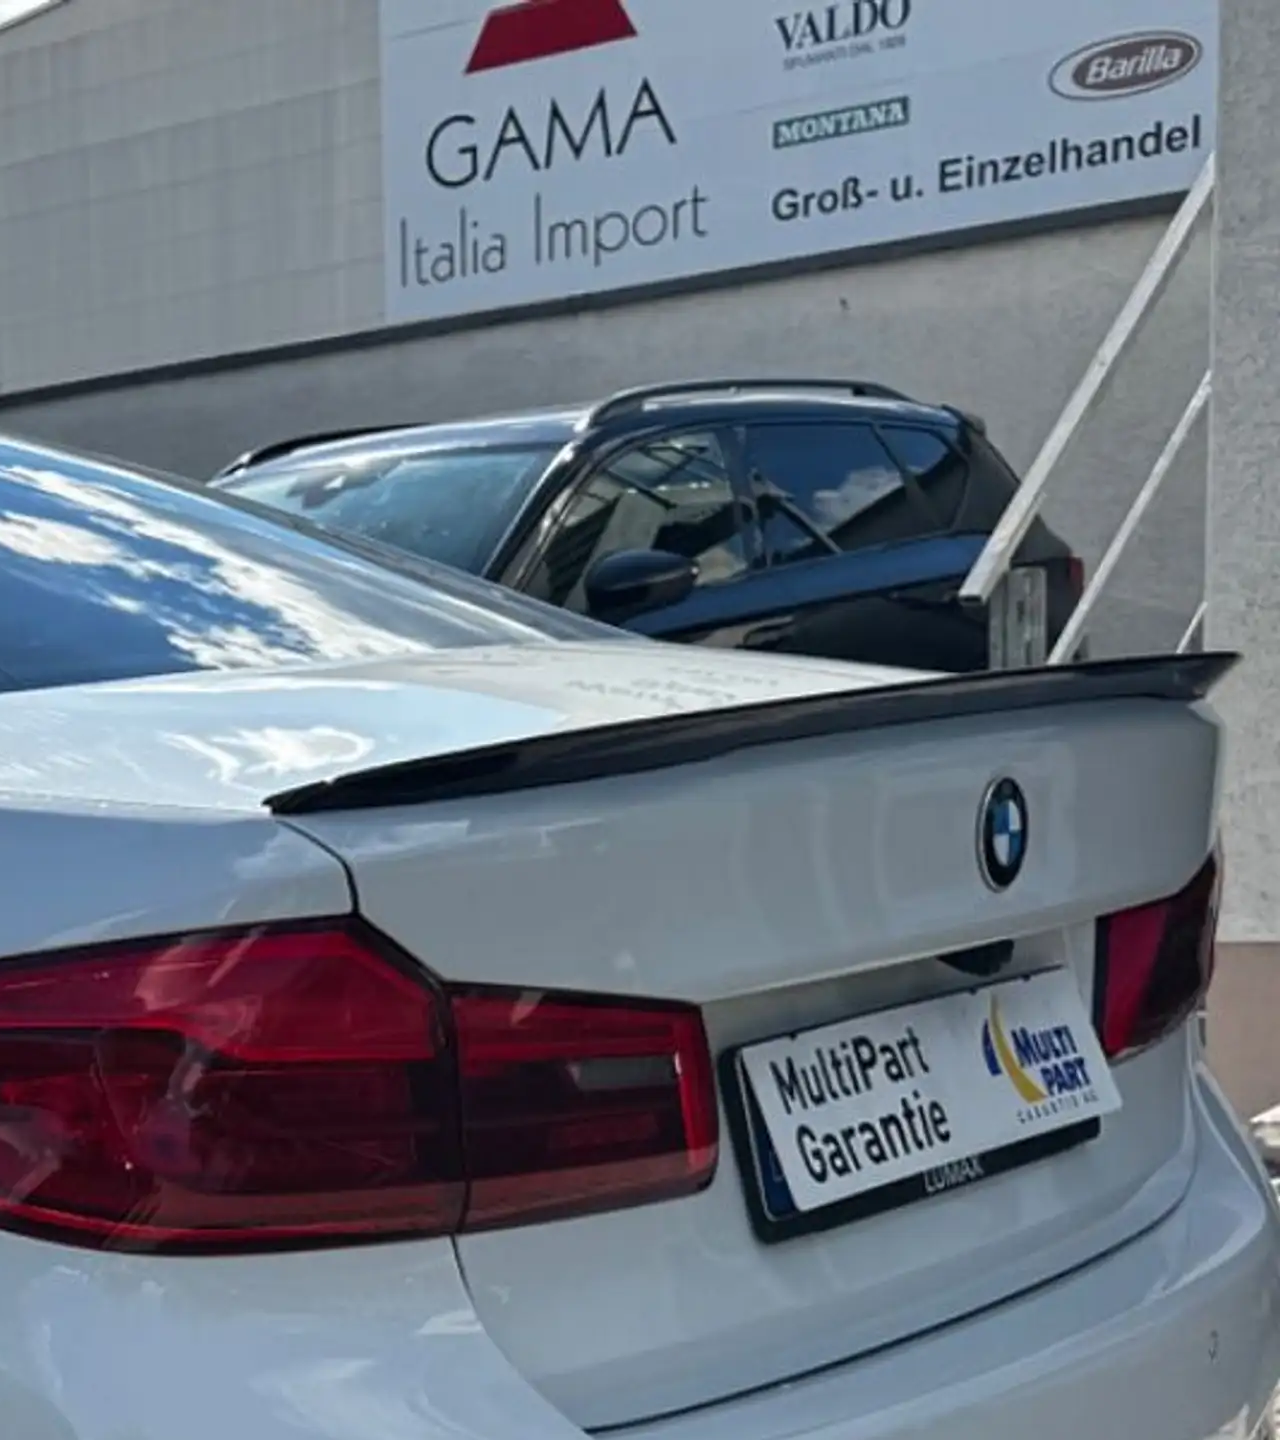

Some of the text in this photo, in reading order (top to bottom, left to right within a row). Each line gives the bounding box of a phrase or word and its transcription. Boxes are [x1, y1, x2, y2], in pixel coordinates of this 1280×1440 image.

[775, 0, 911, 50] VALDO
[1085, 45, 1182, 85] Barilla
[425, 77, 677, 189] GAMA
[772, 114, 1202, 221] Groß- u. Einzelhandel
[777, 101, 905, 145] MONTANA
[400, 184, 708, 288] Italia Import
[769, 1026, 930, 1115] MultiPart
[1041, 1056, 1092, 1097] PART
[796, 1089, 951, 1183] Garantie
